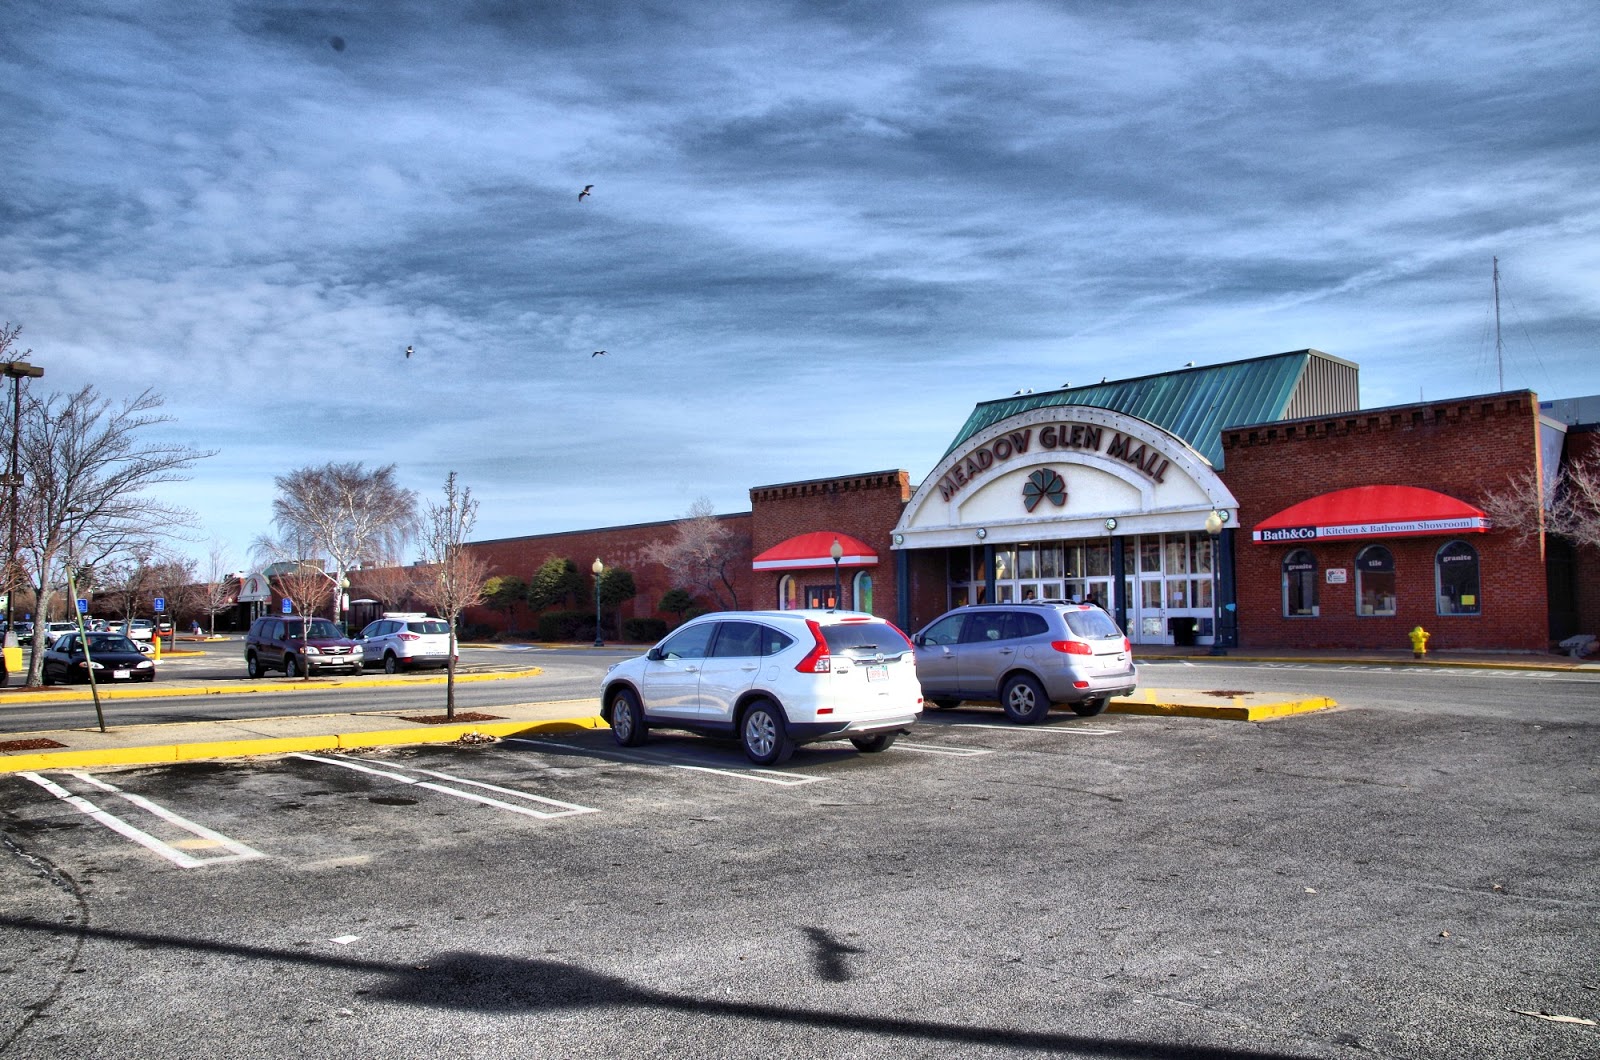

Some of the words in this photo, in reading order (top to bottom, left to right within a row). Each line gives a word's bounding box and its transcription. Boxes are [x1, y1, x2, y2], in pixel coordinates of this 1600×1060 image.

[938, 429, 1031, 502] MEADOW
[1039, 425, 1102, 451] GLEN
[1106, 432, 1170, 484] MALL
[1263, 528, 1316, 541] Bath&Co
[1325, 526, 1359, 536] Kitchen
[1360, 525, 1368, 533] &
[1370, 523, 1415, 533] Bathroom
[1417, 520, 1470, 530] Showroom
[1443, 555, 1472, 563] granite
[1288, 563, 1313, 571] granite
